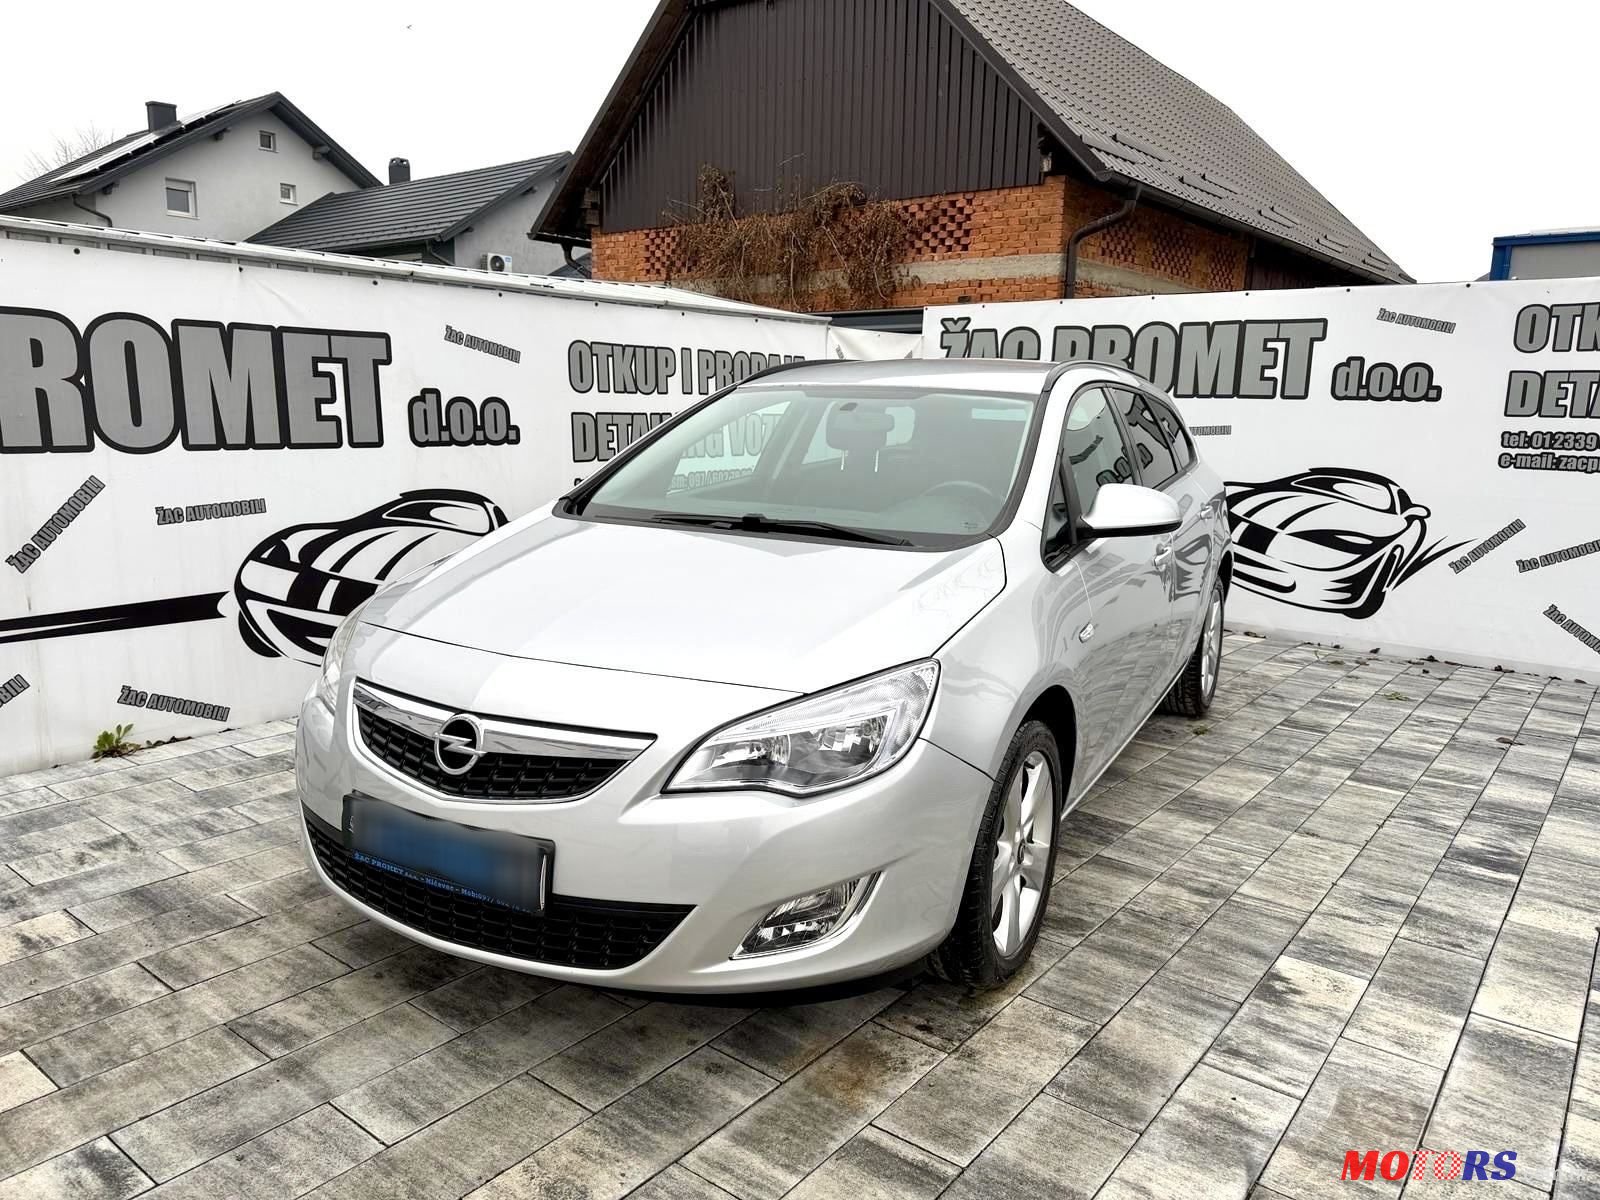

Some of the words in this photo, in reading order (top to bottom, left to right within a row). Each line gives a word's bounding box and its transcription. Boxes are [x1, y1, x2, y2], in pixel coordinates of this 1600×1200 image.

[1395, 313, 1456, 334] AUTOMOBILI
[464, 334, 521, 363] AUTOMOBILI
[568, 340, 676, 394] OTKUP
[681, 347, 693, 395] I
[1331, 356, 1442, 402] d.o.o.
[408, 388, 520, 447] d.o.o.
[1498, 452, 1558, 471] e-mail:
[1558, 454, 1600, 473] zacp
[5, 543, 41, 574] ŽAC
[31, 475, 106, 551] AUTOMOBILI
[155, 506, 184, 525] ŽAC
[186, 498, 267, 522] AUTOMOBILI
[1467, 518, 1526, 562] AUTOMOBILI
[1539, 539, 1600, 567] AUTOMOBI
[117, 685, 148, 707] ŽAC
[146, 694, 230, 722] AUTOMOBILI
